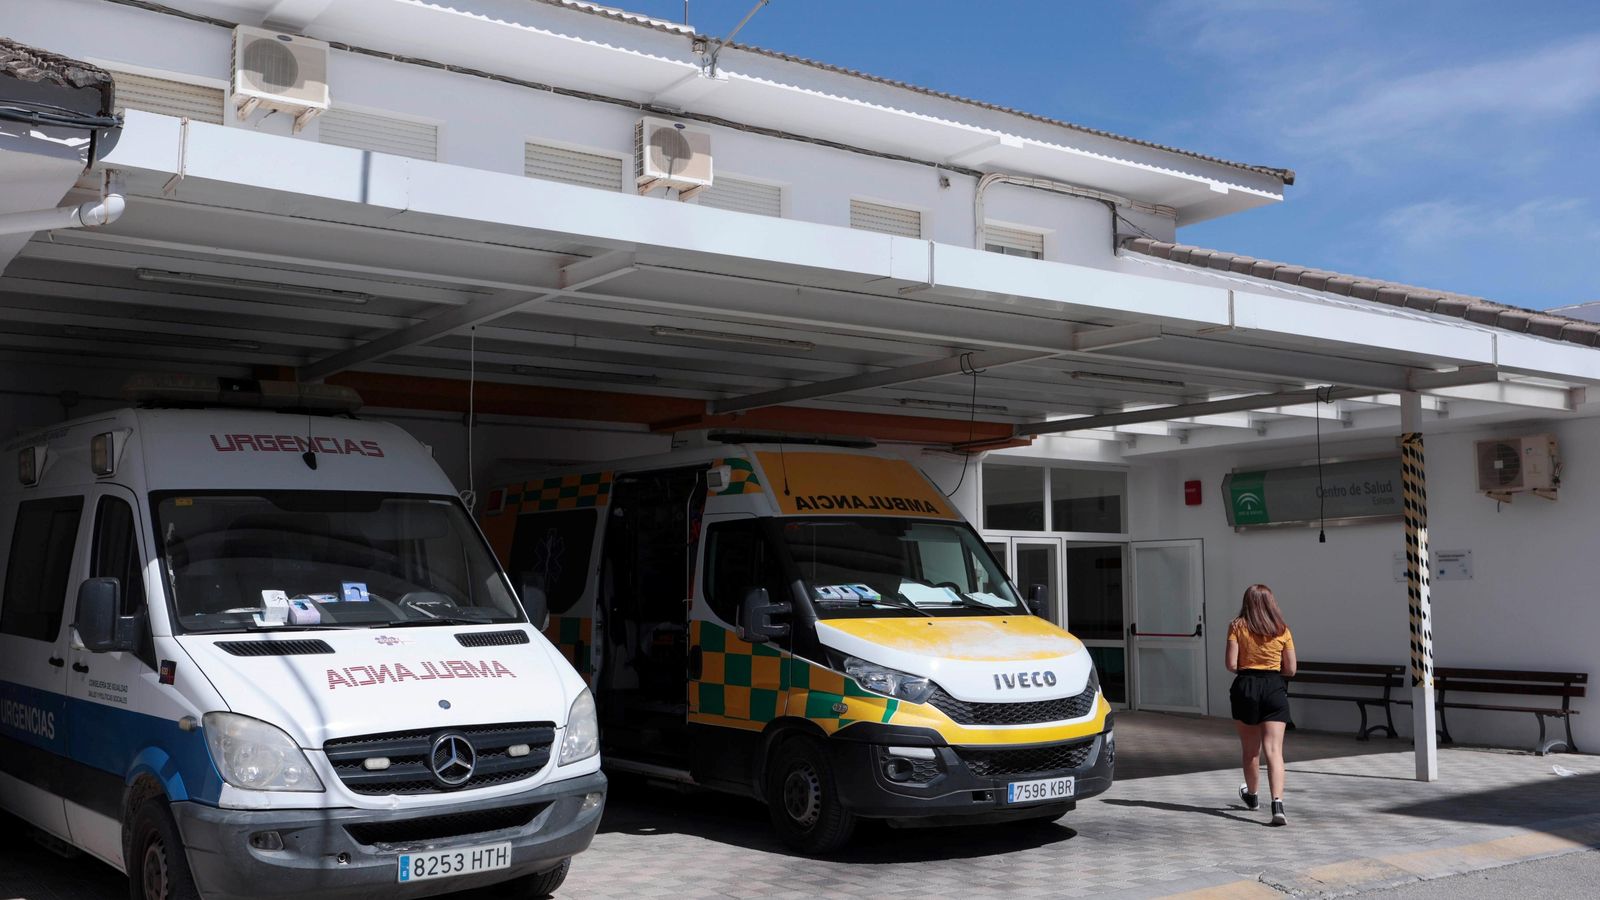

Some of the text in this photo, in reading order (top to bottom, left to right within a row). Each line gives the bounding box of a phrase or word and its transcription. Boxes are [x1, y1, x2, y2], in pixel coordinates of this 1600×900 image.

[209, 434, 385, 458] URGENCIAS
[1316, 480, 1393, 498] Centro de Salud
[993, 670, 1057, 690] IVECO
[1, 699, 55, 740] URGENCIAS
[1016, 780, 1072, 800] 7596 KBR
[414, 846, 507, 877] 8253 HTH
